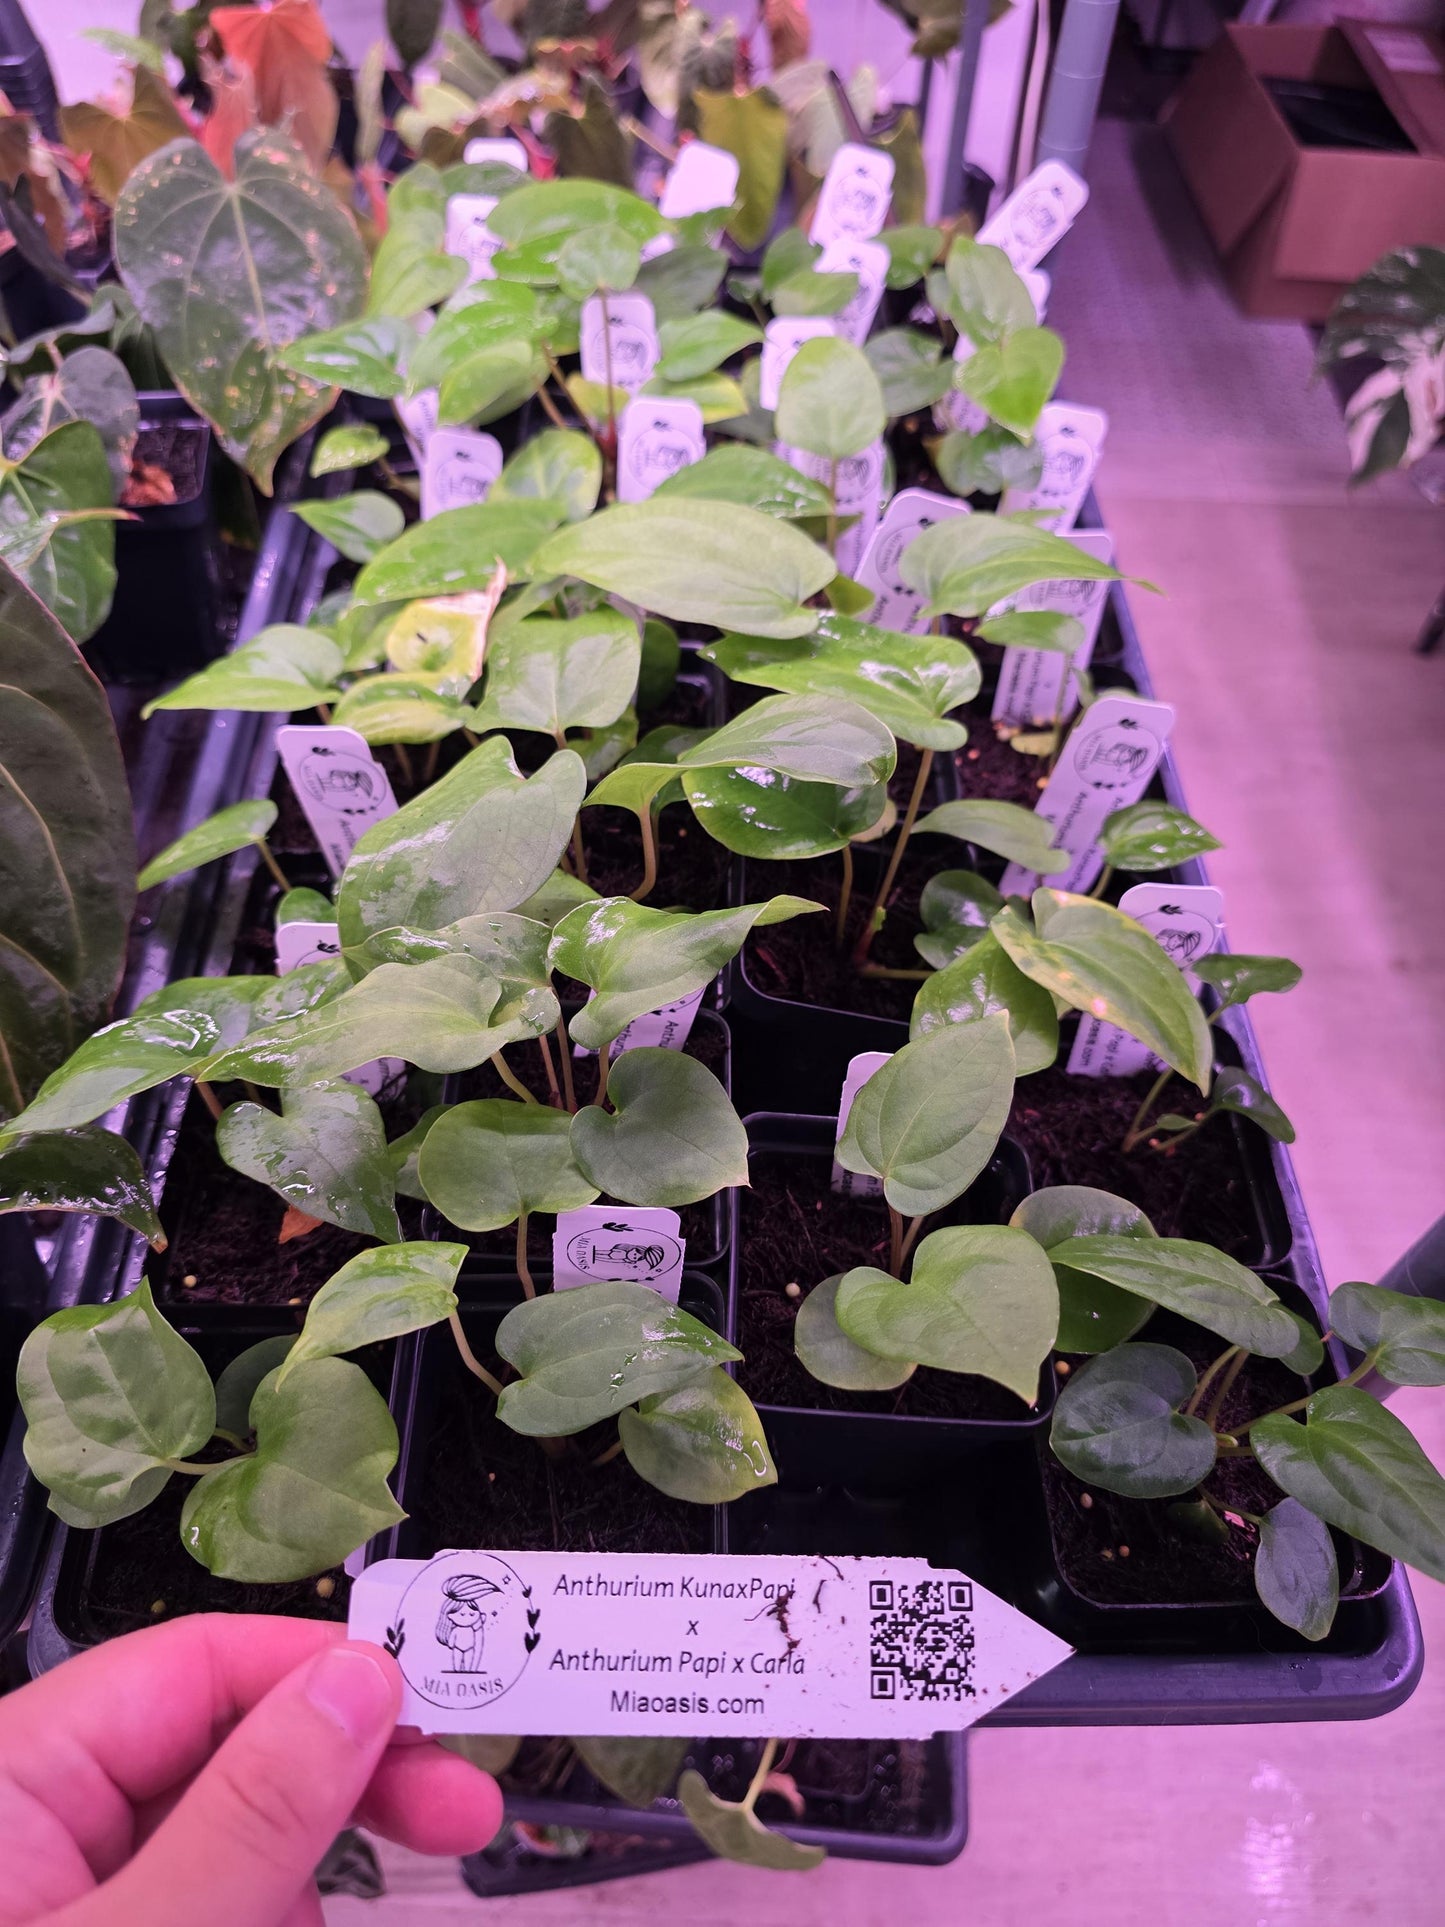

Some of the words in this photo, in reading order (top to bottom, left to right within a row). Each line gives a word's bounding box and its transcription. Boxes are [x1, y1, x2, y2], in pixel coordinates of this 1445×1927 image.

[553, 1572, 674, 1597] Anthurium
[686, 1619, 699, 1636] x
[549, 1647, 672, 1672] Anthurium
[679, 1650, 726, 1678] Papi
[731, 1657, 745, 1674] x
[750, 1651, 805, 1674] Carla
[421, 1675, 450, 1697] MIA
[456, 1677, 504, 1697] OASIS
[610, 1690, 765, 1713] Miaoasis.com
